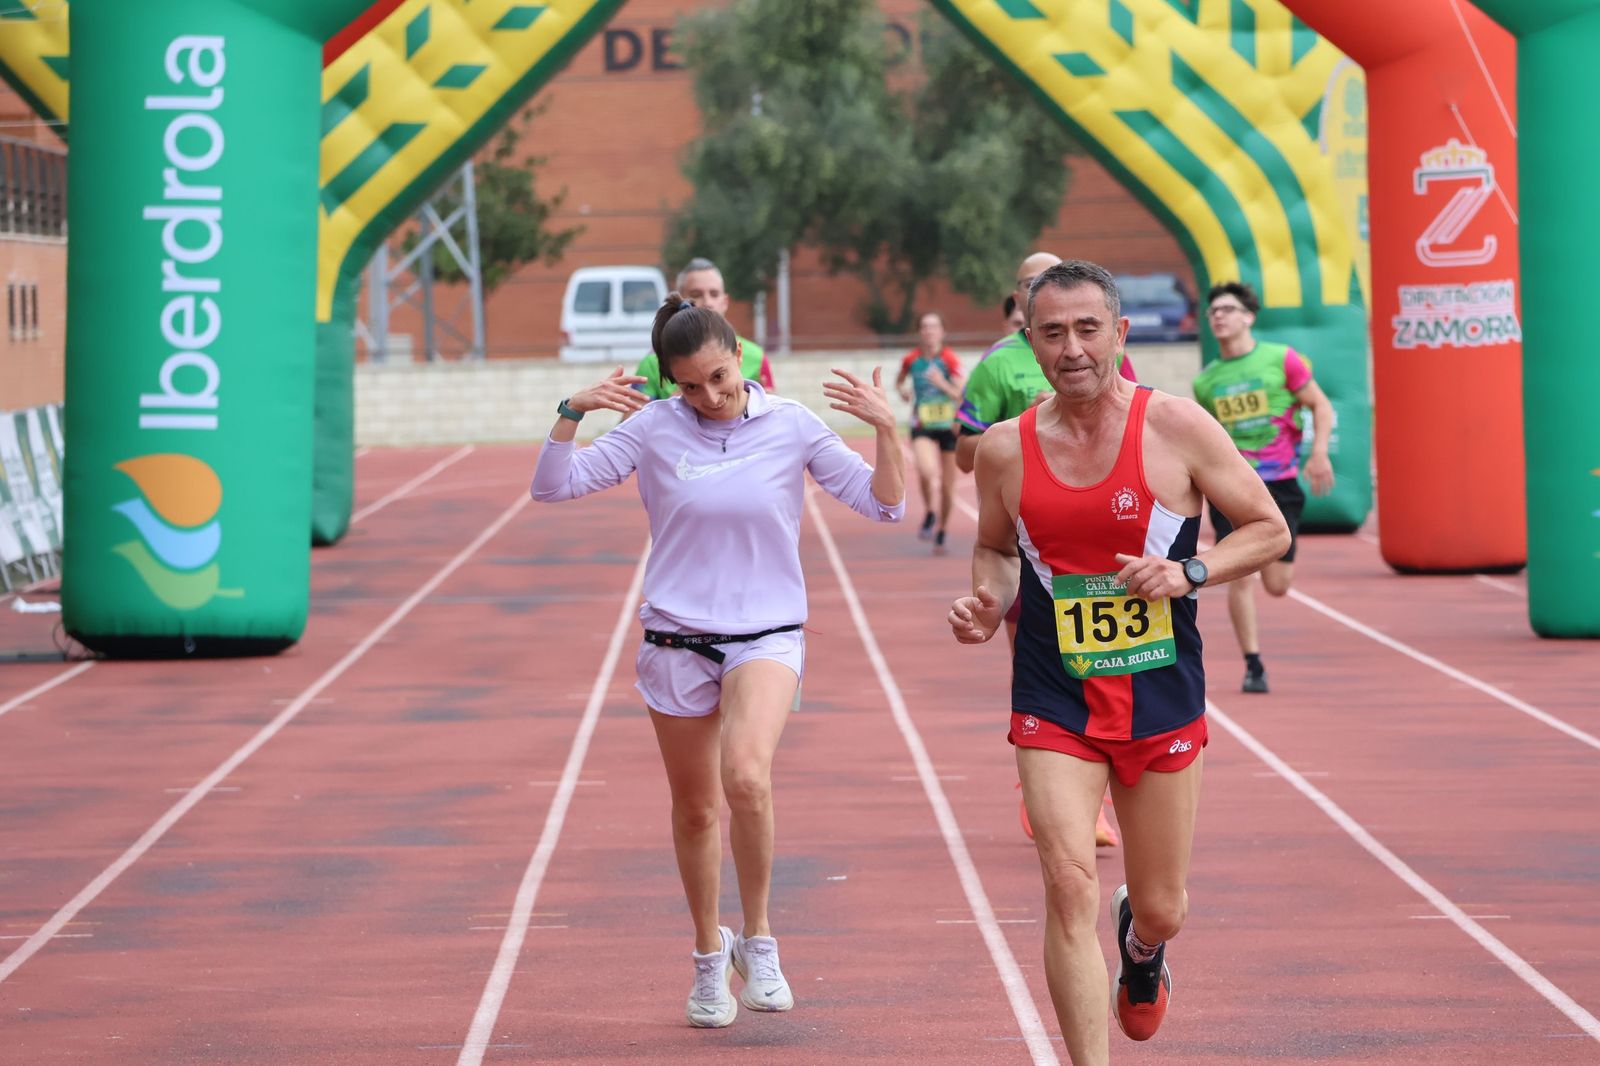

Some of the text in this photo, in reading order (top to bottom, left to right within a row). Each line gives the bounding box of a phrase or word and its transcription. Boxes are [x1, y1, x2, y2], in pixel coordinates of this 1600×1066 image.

[139, 34, 226, 430] Iberdrola
[1394, 314, 1520, 346] ZAMORA
[1218, 392, 1260, 418] 339
[1086, 583, 1108, 591] CAJA
[1064, 598, 1149, 643] 153
[1094, 648, 1169, 669] CAJA RURAL
